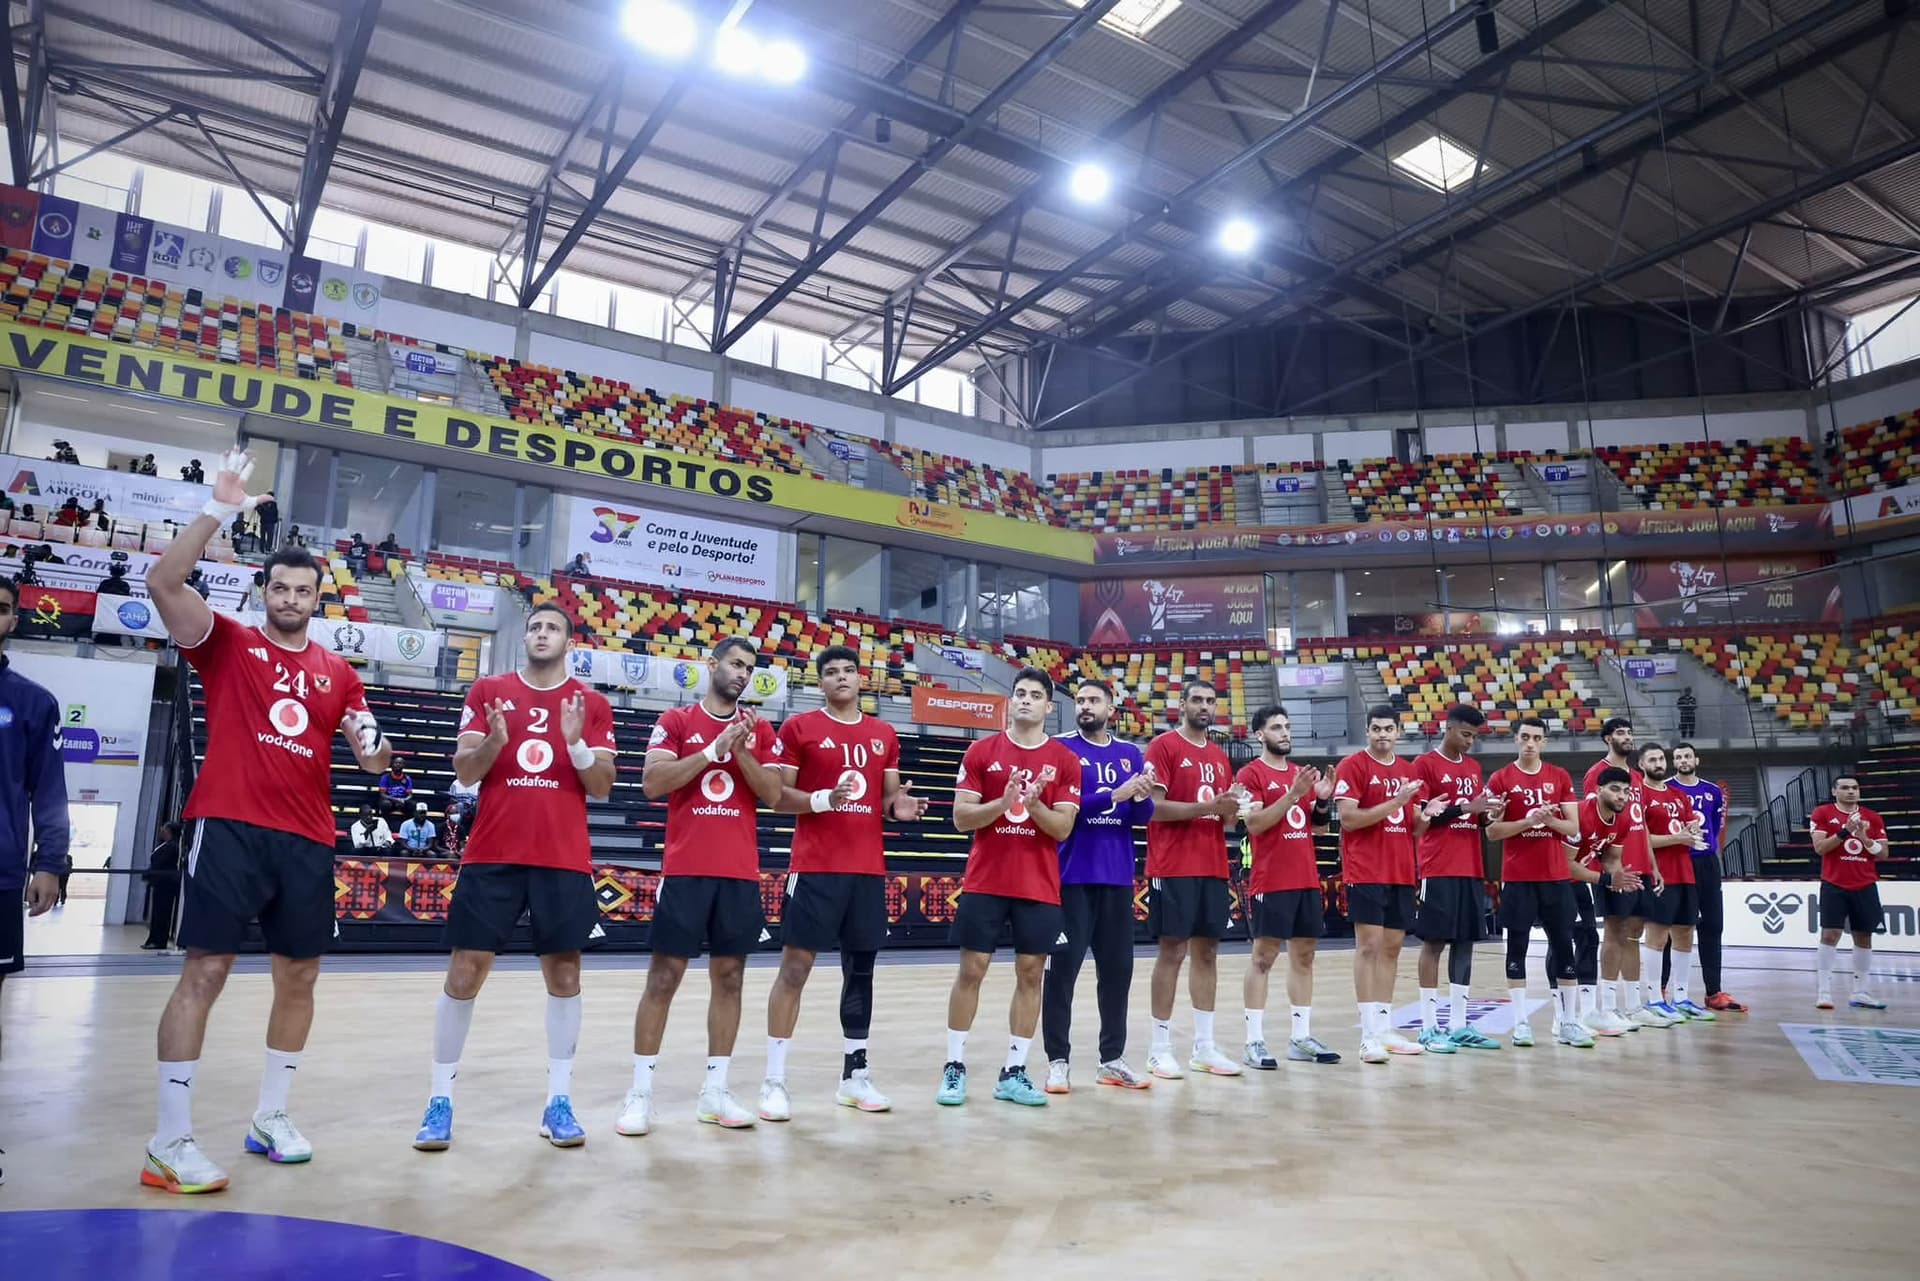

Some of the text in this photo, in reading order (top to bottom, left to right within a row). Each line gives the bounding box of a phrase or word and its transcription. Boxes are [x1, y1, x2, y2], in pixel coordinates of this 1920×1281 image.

[410, 353, 434, 365] SECTOR
[8, 332, 774, 501] VENTUDE E DESPORTOS
[45, 485, 113, 502] ANGOLA
[590, 507, 640, 543] 37
[646, 523, 758, 551] Com a Juventude
[1153, 536, 1194, 552] ÁFRICA
[1198, 537, 1228, 549] JOGA
[1232, 534, 1261, 550] AQUI
[648, 540, 755, 565] e pelo Desporto!
[436, 585, 465, 598] SECTOR
[1767, 592, 1793, 609] AQUI
[445, 597, 456, 609] 11
[1229, 610, 1253, 626] AQUI
[272, 662, 309, 699] 24
[927, 697, 994, 713] DESPORTO
[70, 710, 82, 722] 2
[527, 707, 549, 733] 2
[257, 732, 314, 758] vodafone
[841, 743, 867, 768] 10
[1095, 762, 1117, 783] 16
[1198, 761, 1215, 783] 18
[506, 776, 559, 789] vodafone
[1383, 777, 1400, 797] 22
[1456, 777, 1473, 795] 28
[1524, 788, 1544, 806] 31
[692, 805, 740, 817] vodafone
[1087, 816, 1122, 826] vodafone
[995, 825, 1036, 836] vodafone
